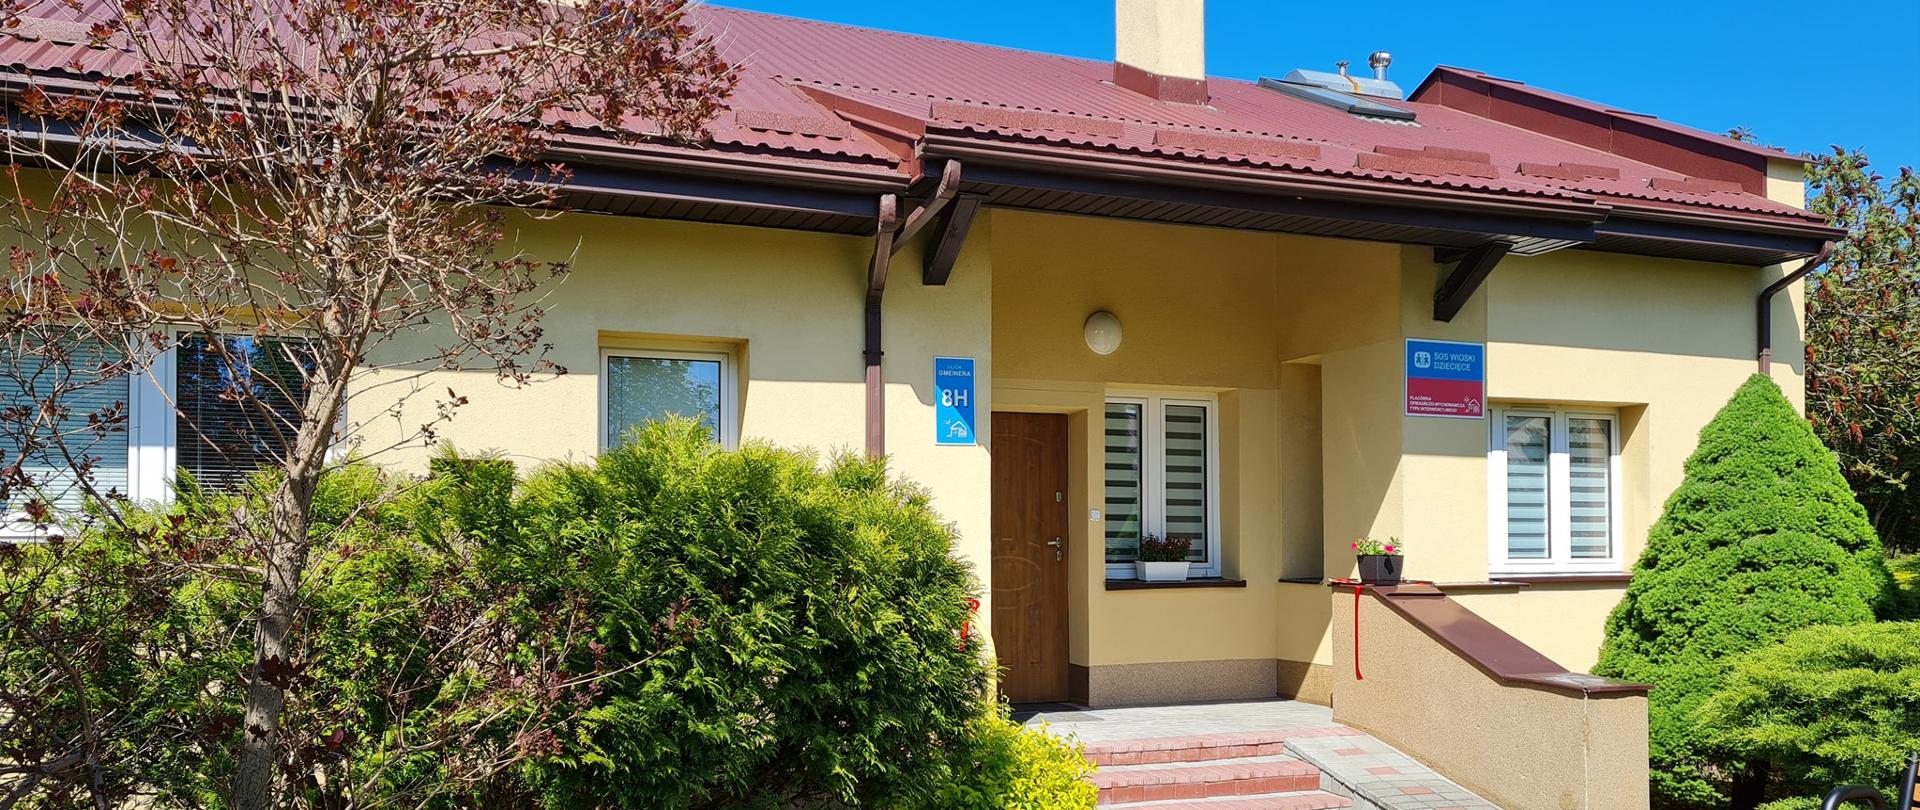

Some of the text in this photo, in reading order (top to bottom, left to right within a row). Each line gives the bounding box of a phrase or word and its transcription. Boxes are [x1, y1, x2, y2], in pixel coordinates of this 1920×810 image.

[1434, 352, 1476, 362] SOS WIOSKI
[1434, 362, 1472, 371] DZIECIĘCE
[941, 388, 968, 407] 8H
